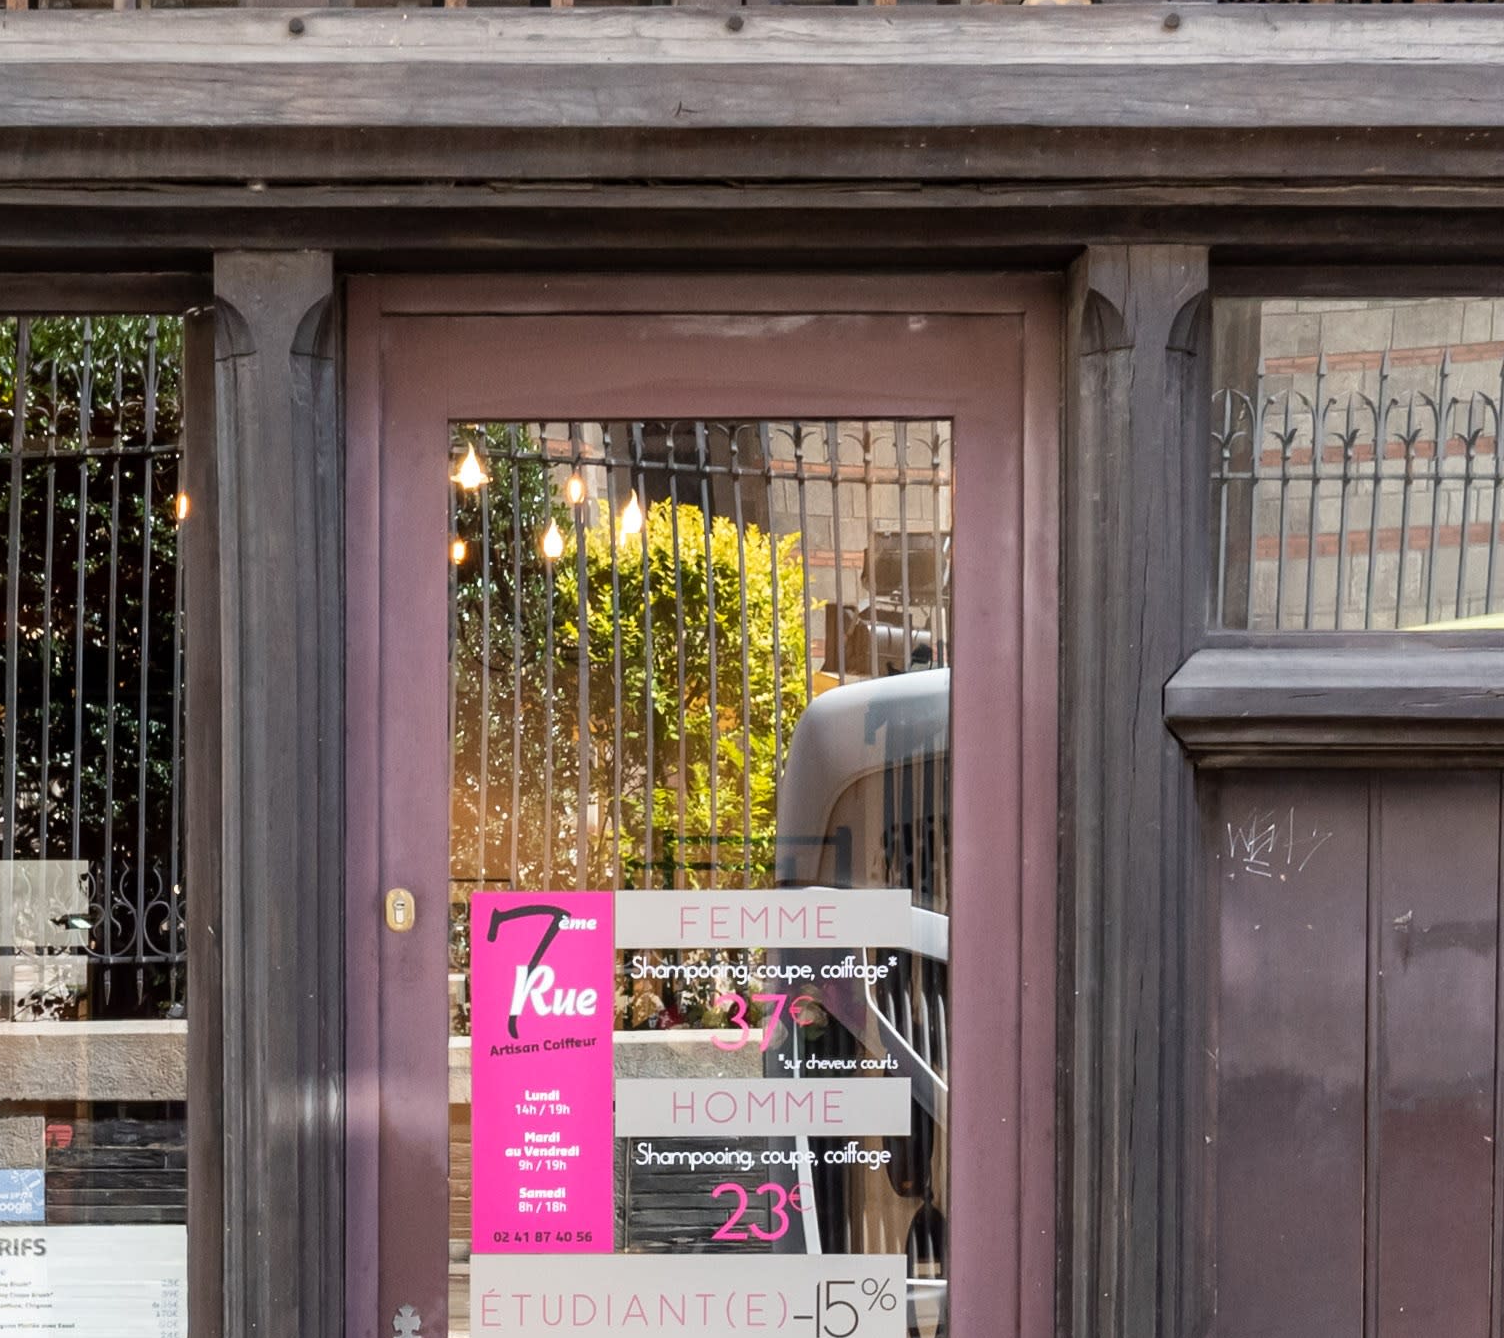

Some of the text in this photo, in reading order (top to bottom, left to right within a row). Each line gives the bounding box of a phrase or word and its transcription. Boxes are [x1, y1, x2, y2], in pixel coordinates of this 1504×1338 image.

[680, 905, 837, 939] FEMME
[630, 955, 752, 985] Shampooing,
[756, 963, 816, 985] coupe,
[509, 964, 598, 1017] Rue
[490, 1037, 598, 1057] Artisan Coiffeur
[805, 1053, 857, 1071] cheveux
[860, 1053, 899, 1071] courts
[525, 1089, 560, 1102] Lundi
[515, 1104, 537, 1115] 14h
[549, 1104, 570, 1115] 19h
[673, 1091, 843, 1124] HOMME
[524, 1131, 561, 1143] Mardi
[505, 1145, 580, 1158] au Vendredi
[635, 1141, 892, 1171] Shampooing, coupe, coiffage
[518, 1160, 534, 1171] 9h
[545, 1160, 567, 1171] 19h
[519, 1187, 566, 1199] Samedi
[518, 1202, 534, 1213] 8h
[545, 1202, 567, 1213] 18h
[493, 1231, 593, 1243] 02 41 87 40 56
[481, 1277, 898, 1338] ÉTUDIANT(E) -15%
